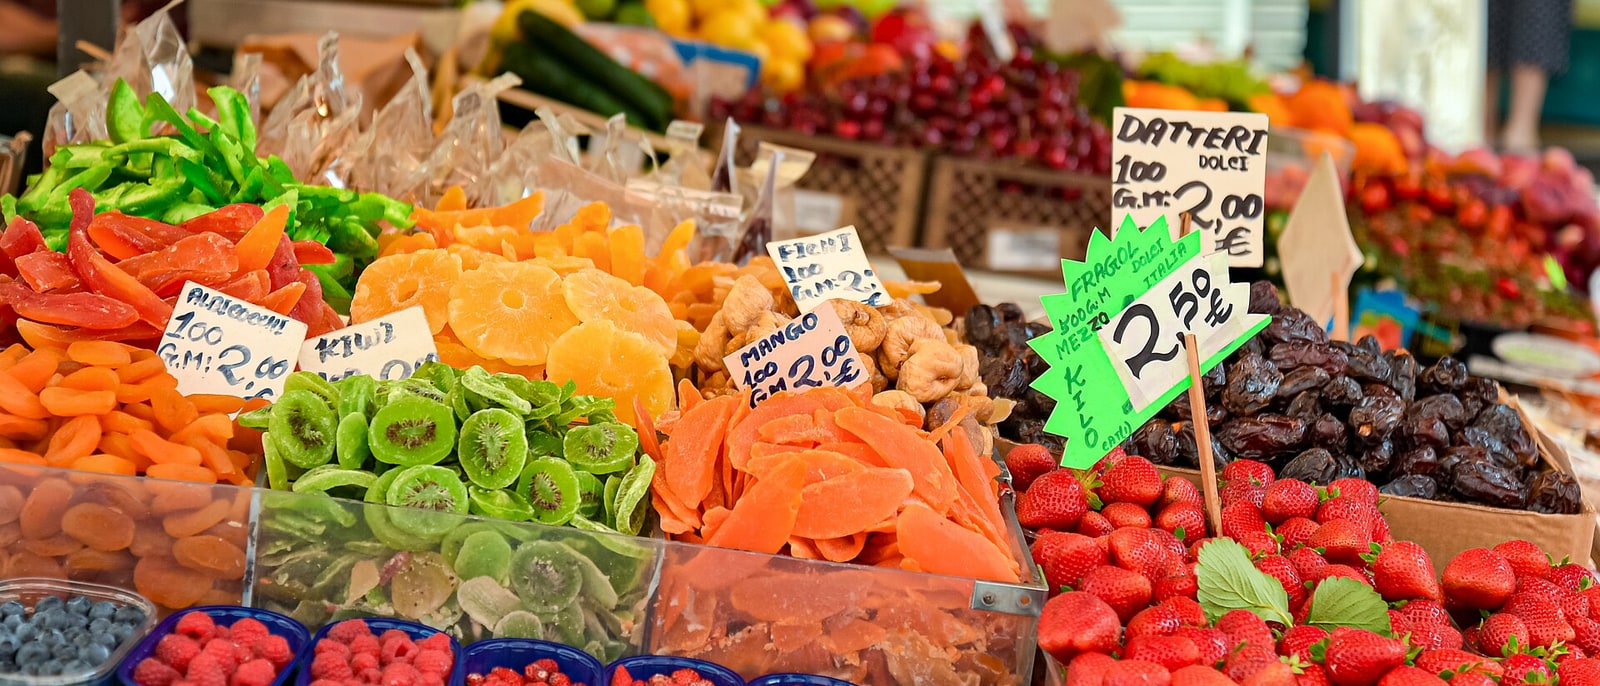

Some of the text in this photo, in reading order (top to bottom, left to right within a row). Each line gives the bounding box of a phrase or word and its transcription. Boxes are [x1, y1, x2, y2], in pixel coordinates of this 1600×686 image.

[1117, 114, 1268, 155] DATTERI
[1113, 154, 1167, 184] 100
[1199, 155, 1249, 172] DOLCI
[1173, 180, 1263, 234] 2,00
[1132, 238, 1164, 274] DOLCI
[1214, 226, 1253, 256] €
[783, 263, 824, 283] 100
[1071, 241, 1140, 303] FRAGOL
[1143, 242, 1187, 290] ITALIA
[165, 311, 224, 346] 100
[1204, 288, 1233, 328] €
[740, 312, 819, 368] MANGO
[1055, 311, 1111, 360] MEZZO
[216, 344, 289, 391] 2,00
[743, 361, 778, 390] 100
[788, 335, 850, 388] 2,00
[832, 357, 861, 387] €
[1064, 364, 1099, 448] KILO
